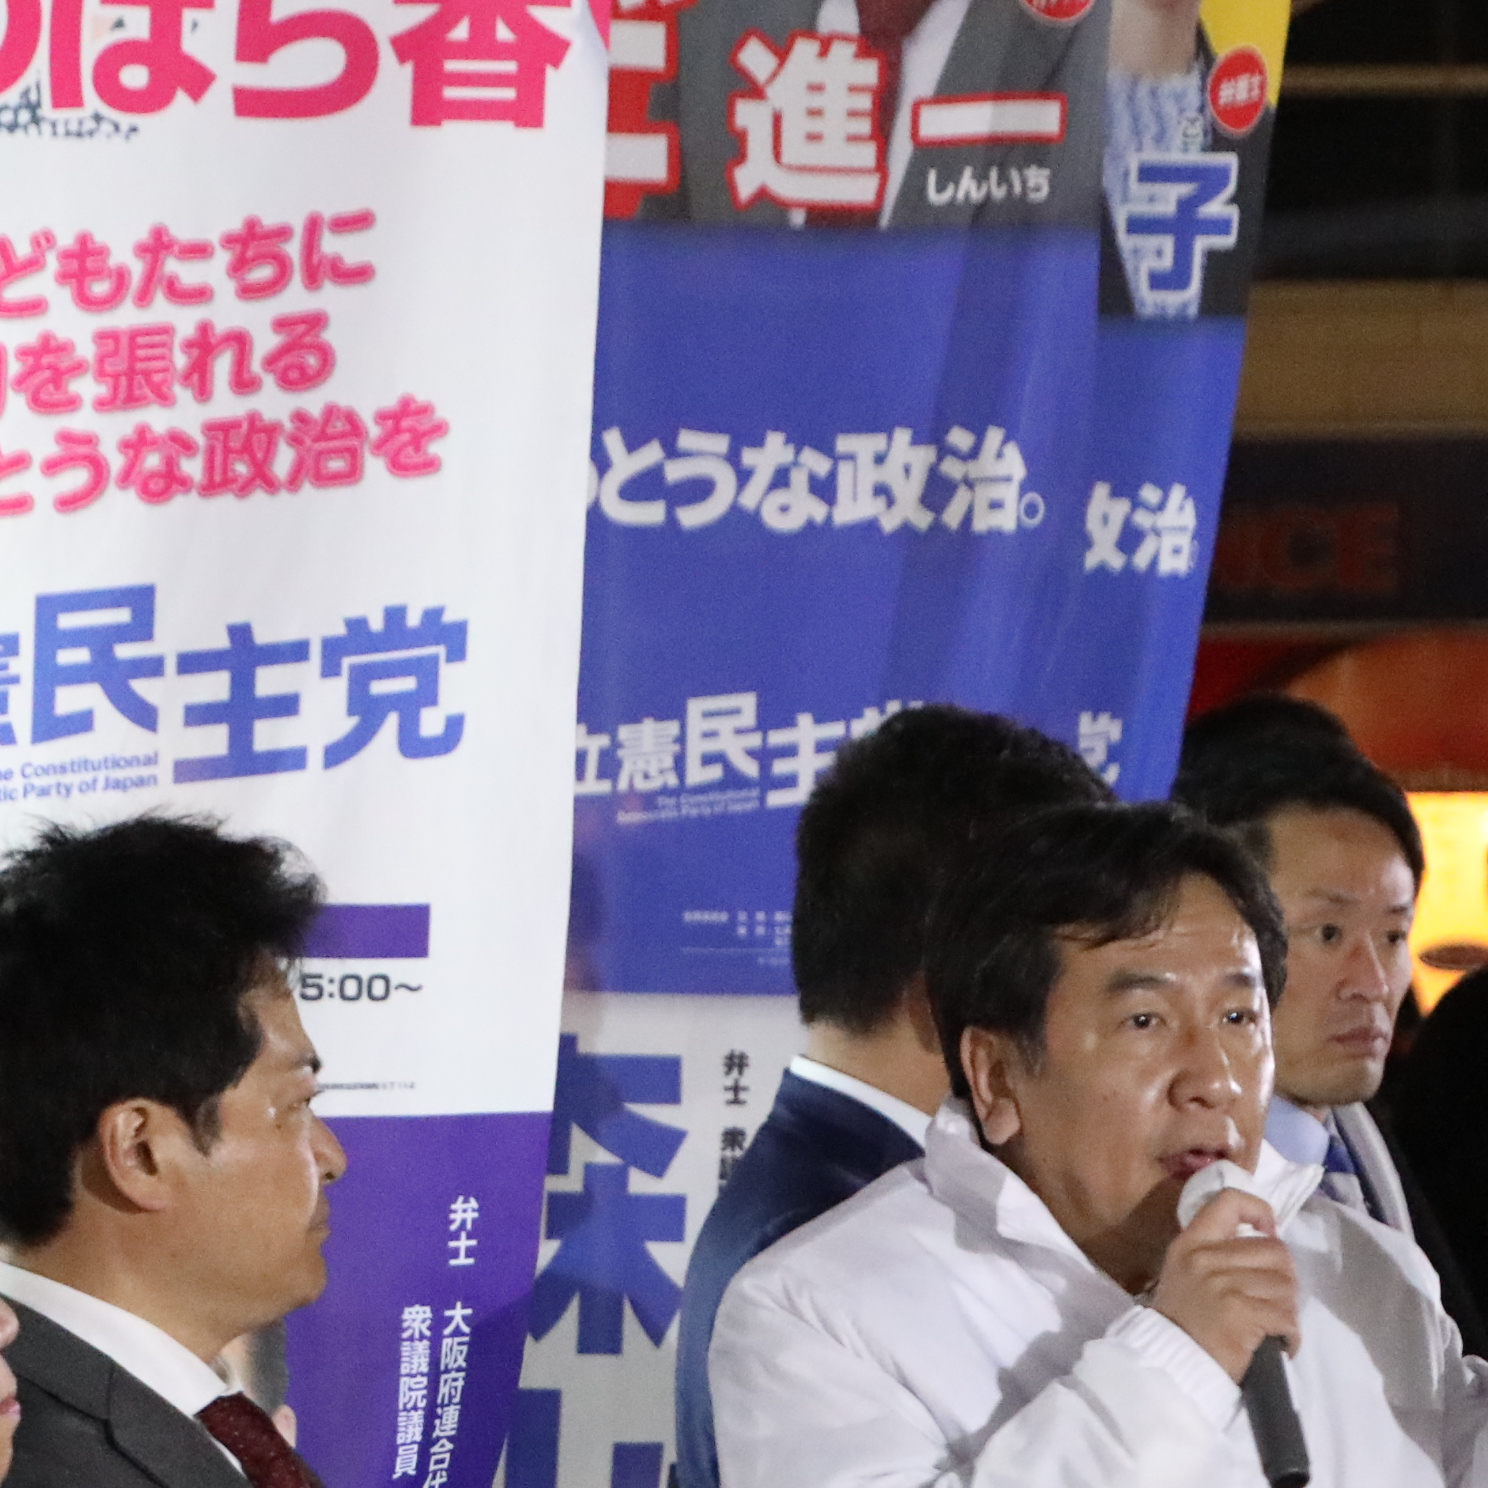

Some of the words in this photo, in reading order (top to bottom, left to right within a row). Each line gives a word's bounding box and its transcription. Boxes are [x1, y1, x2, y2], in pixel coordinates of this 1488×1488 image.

[927, 165, 1051, 205] しんいち
[587, 423, 1046, 534] とうな政治。
[20, 751, 159, 780] Constitutional
[22, 779, 73, 799] Party
[78, 774, 99, 793] of
[103, 772, 158, 793] Japan
[574, 690, 924, 810] 立憲民主
[447, 1195, 480, 1267] 弁士
[392, 1303, 434, 1481] 衆議院議員
